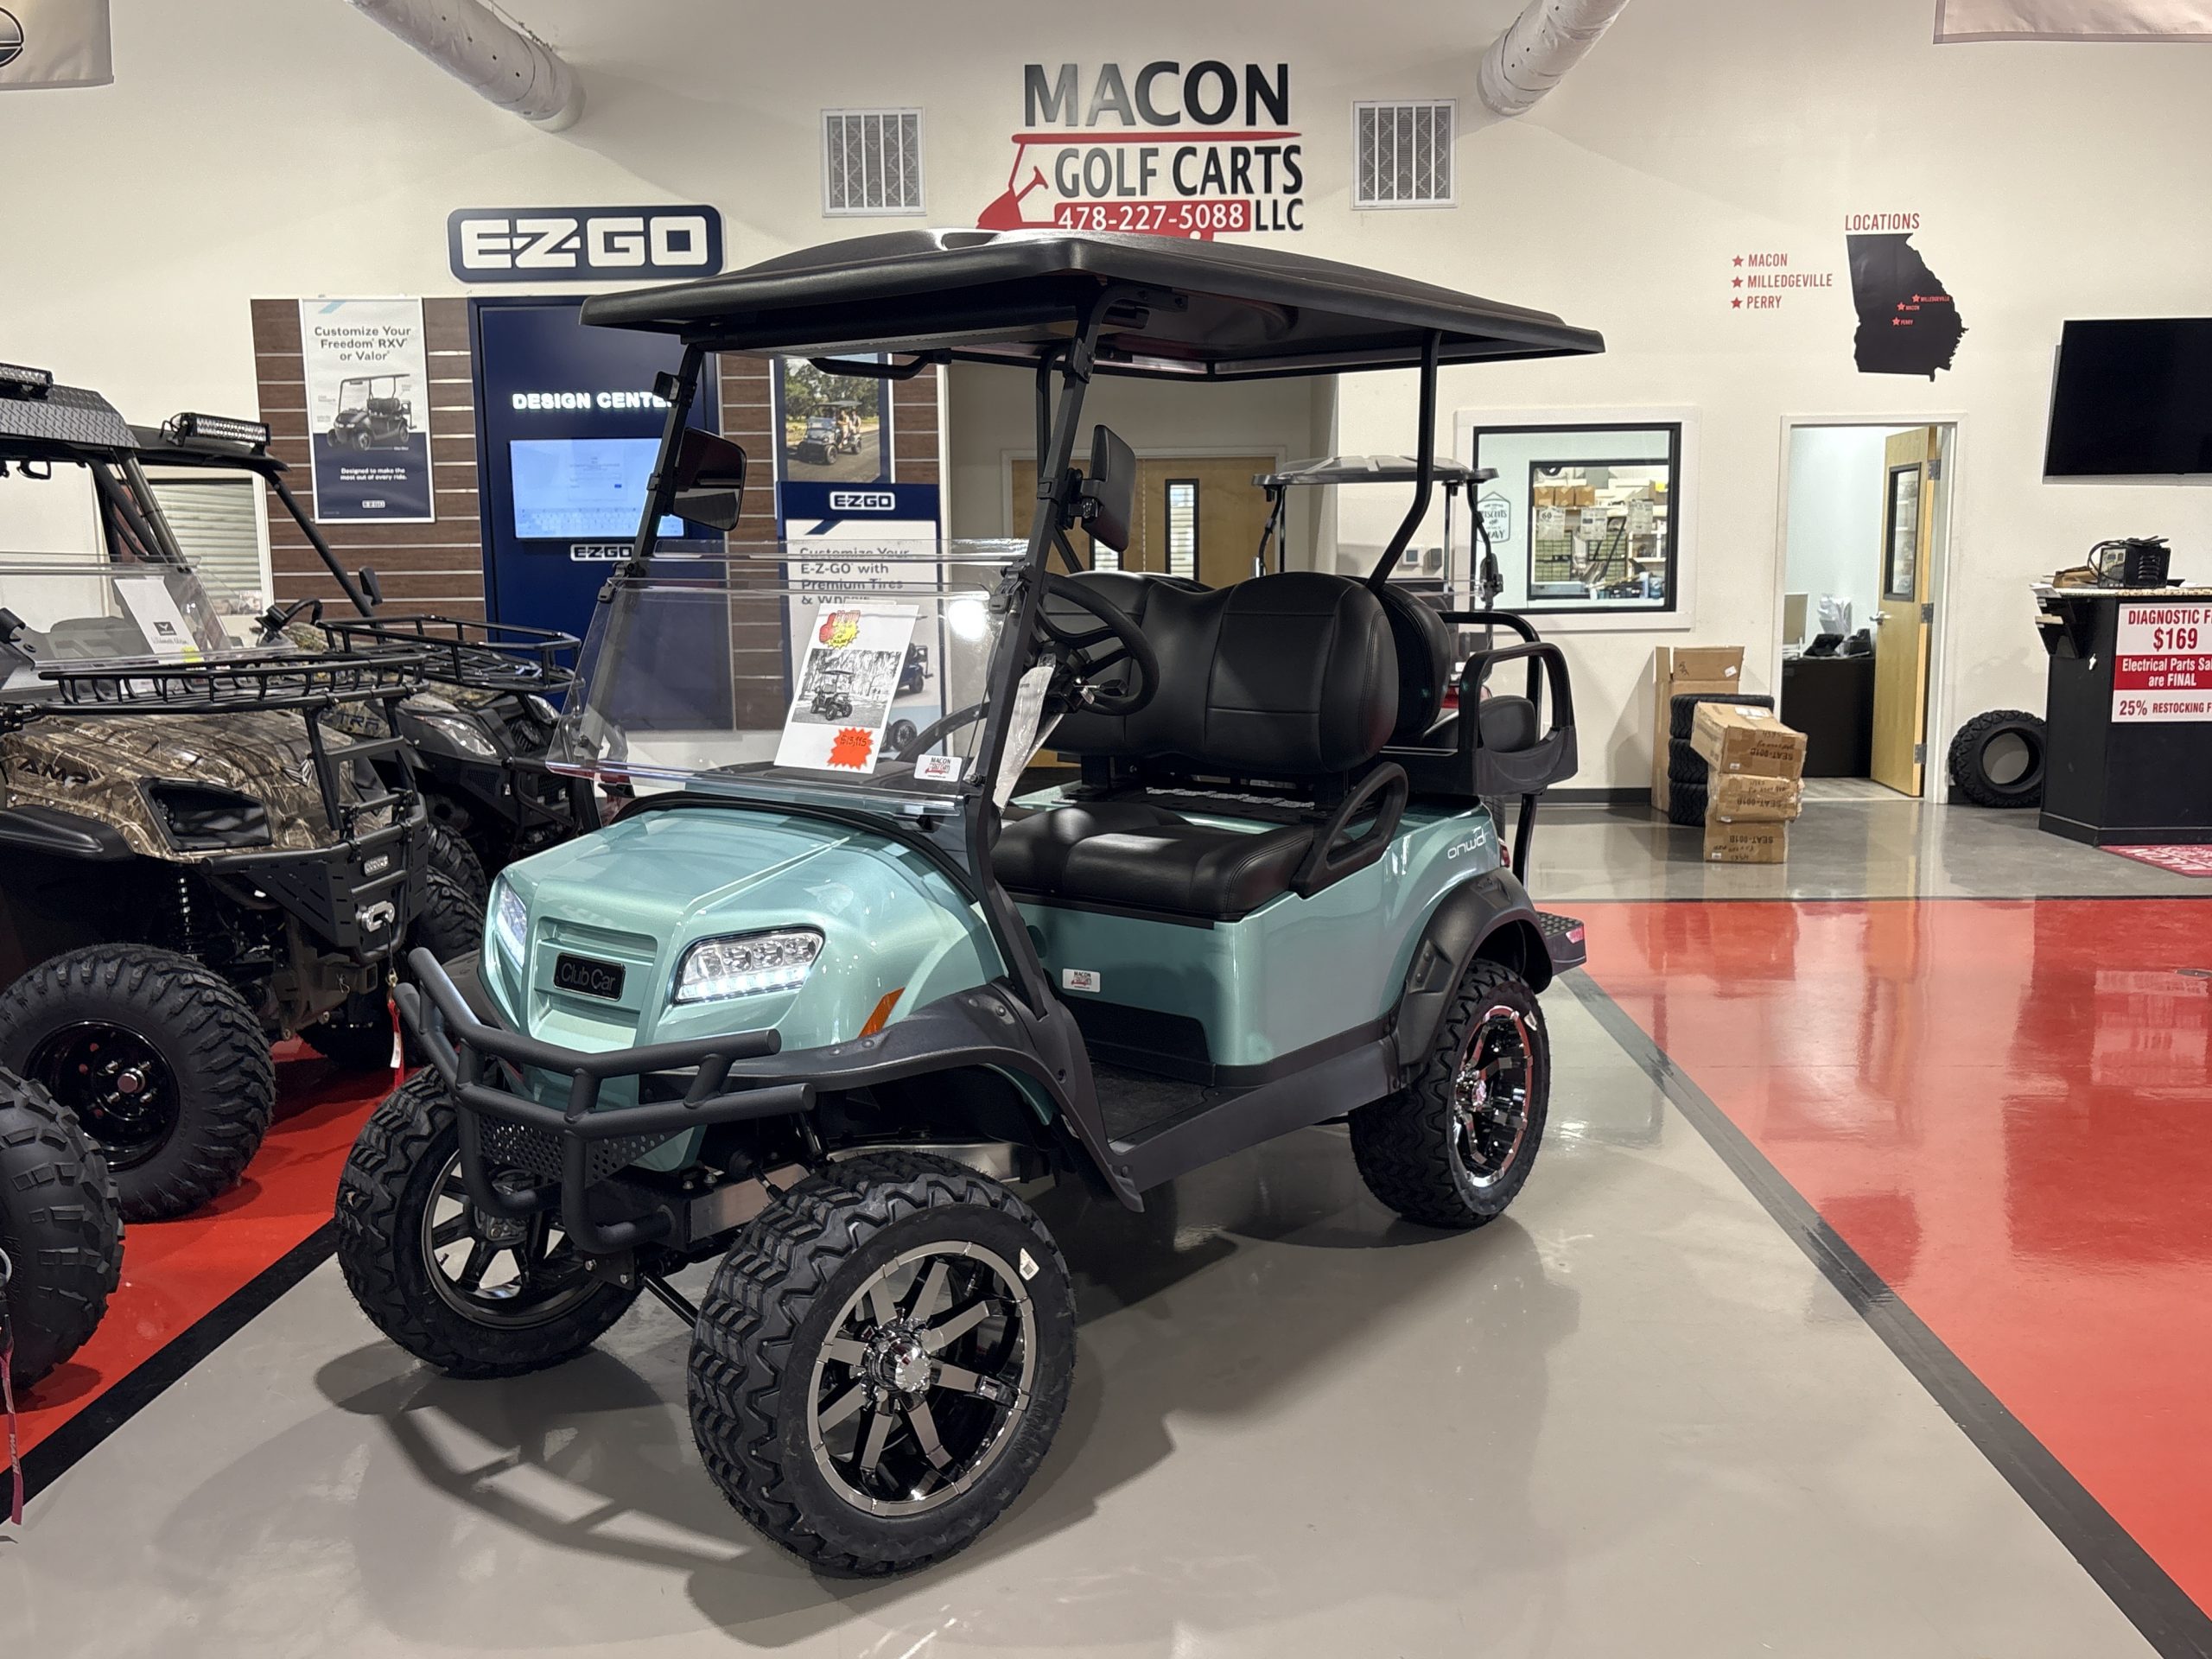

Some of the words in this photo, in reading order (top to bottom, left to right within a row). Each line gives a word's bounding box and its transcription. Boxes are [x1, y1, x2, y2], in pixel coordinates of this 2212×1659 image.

[1024, 60, 1288, 126] MACON
[1055, 147, 1159, 197] GOLF
[1173, 145, 1303, 194] CARTS
[1058, 203, 1244, 231] 478-227-5088
[1255, 198, 1304, 231] LLC
[1845, 213, 1920, 231] LOCATIONS
[1748, 253, 1788, 267] MACON
[1747, 273, 1833, 288] MILLEDGEVILLE
[1746, 296, 1782, 308] PERRY
[314, 326, 379, 336] Customize
[382, 326, 411, 336] Your
[340, 353, 353, 361] or
[512, 392, 592, 410] DESIGN
[596, 391, 672, 409] CENTE
[340, 467, 369, 475] Designed
[857, 563, 889, 574] with
[801, 579, 865, 590] Premium
[869, 579, 904, 590] Tires
[801, 595, 813, 605] &
[2128, 609, 2200, 625] DIAGNOSTIC
[2203, 609, 2212, 624] F
[2153, 627, 2198, 652] $169
[2122, 658, 2167, 672] Electrical
[2170, 658, 2196, 671] Parts
[2148, 676, 2164, 687] are
[2167, 673, 2197, 686] FINAL
[2119, 700, 2148, 716] 25%
[2152, 702, 2204, 714] RESTOCKING
[561, 963, 590, 986] Club
[590, 969, 616, 991] Car
